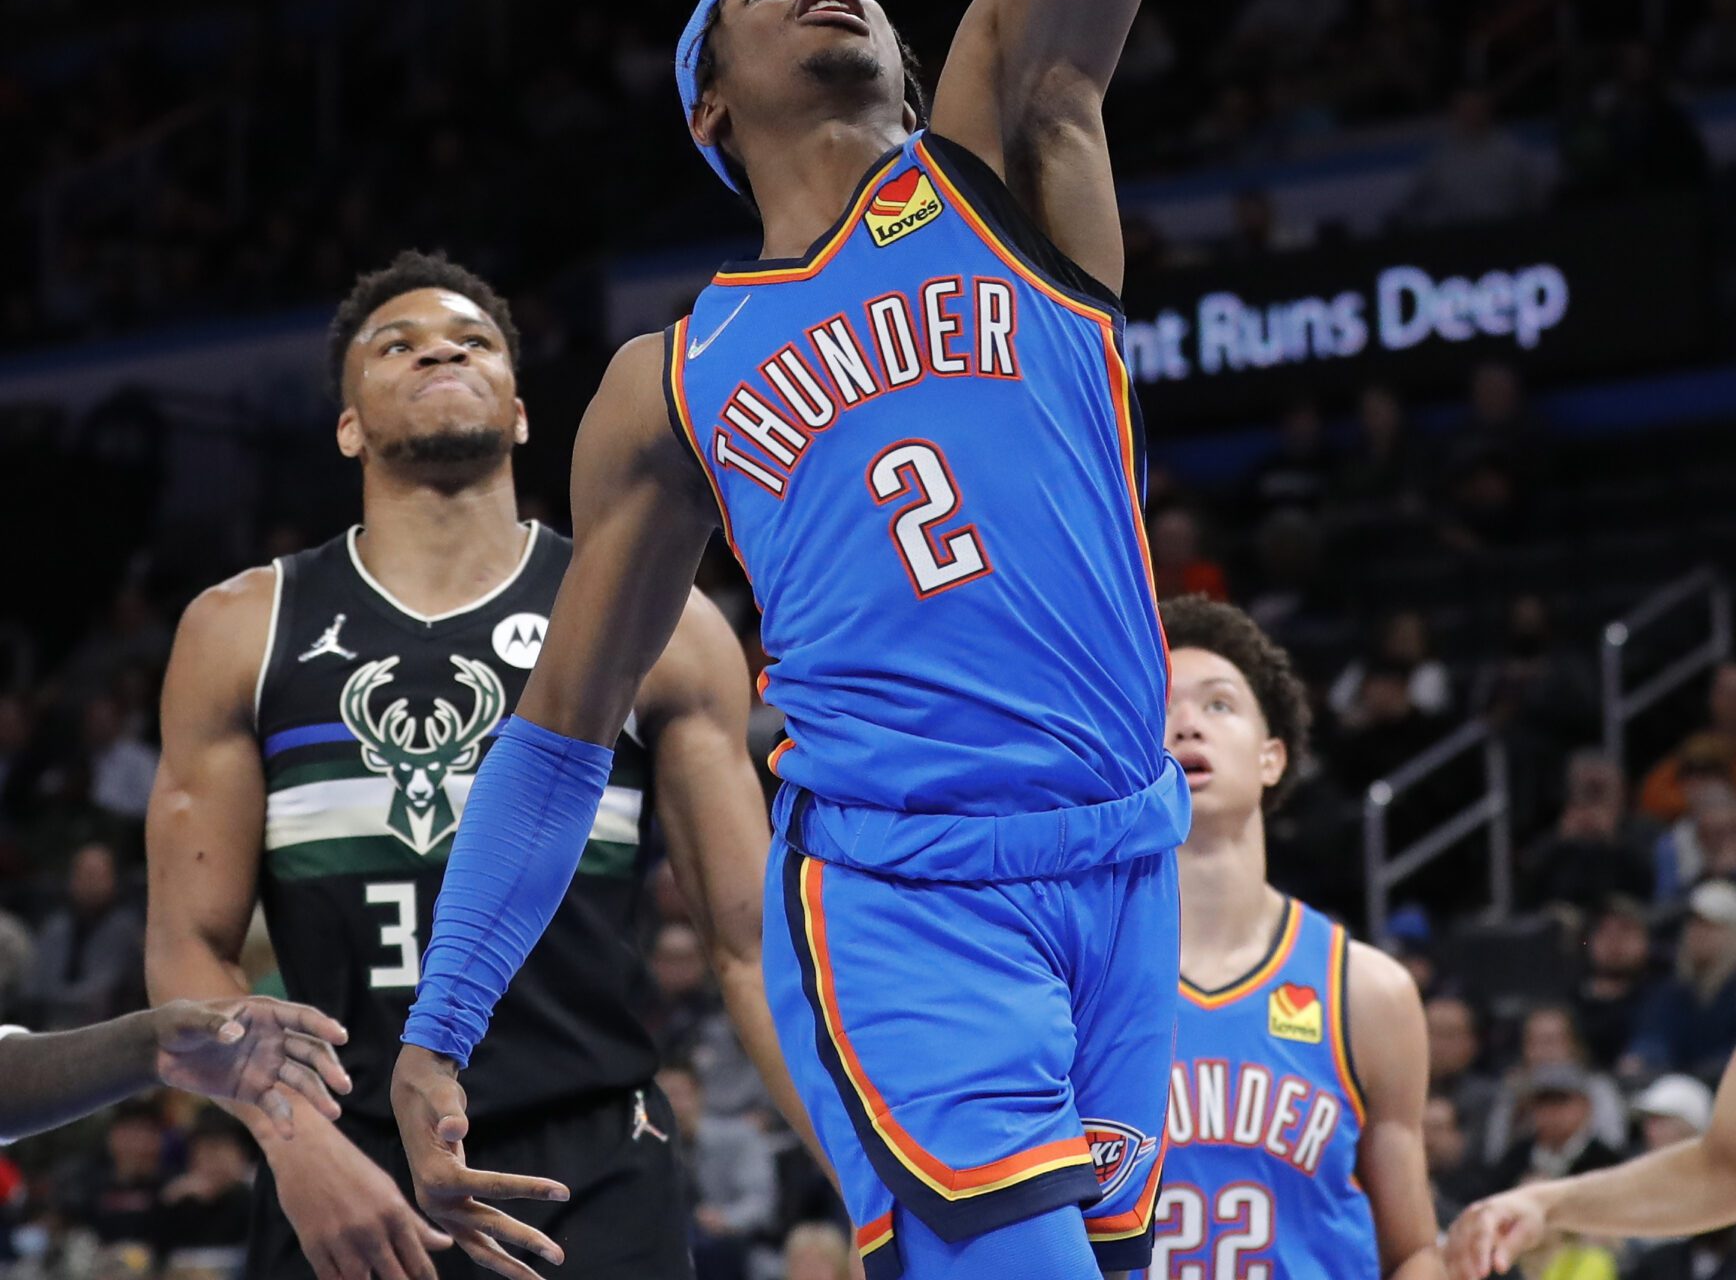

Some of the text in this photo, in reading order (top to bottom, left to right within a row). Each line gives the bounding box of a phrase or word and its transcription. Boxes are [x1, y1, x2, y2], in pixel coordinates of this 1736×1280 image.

[714, 275, 1022, 499] THUNDER
[1198, 291, 1369, 375] Runs
[1377, 263, 1569, 350] Deep
[865, 438, 994, 600] 2
[1147, 1180, 1276, 1280] 22
